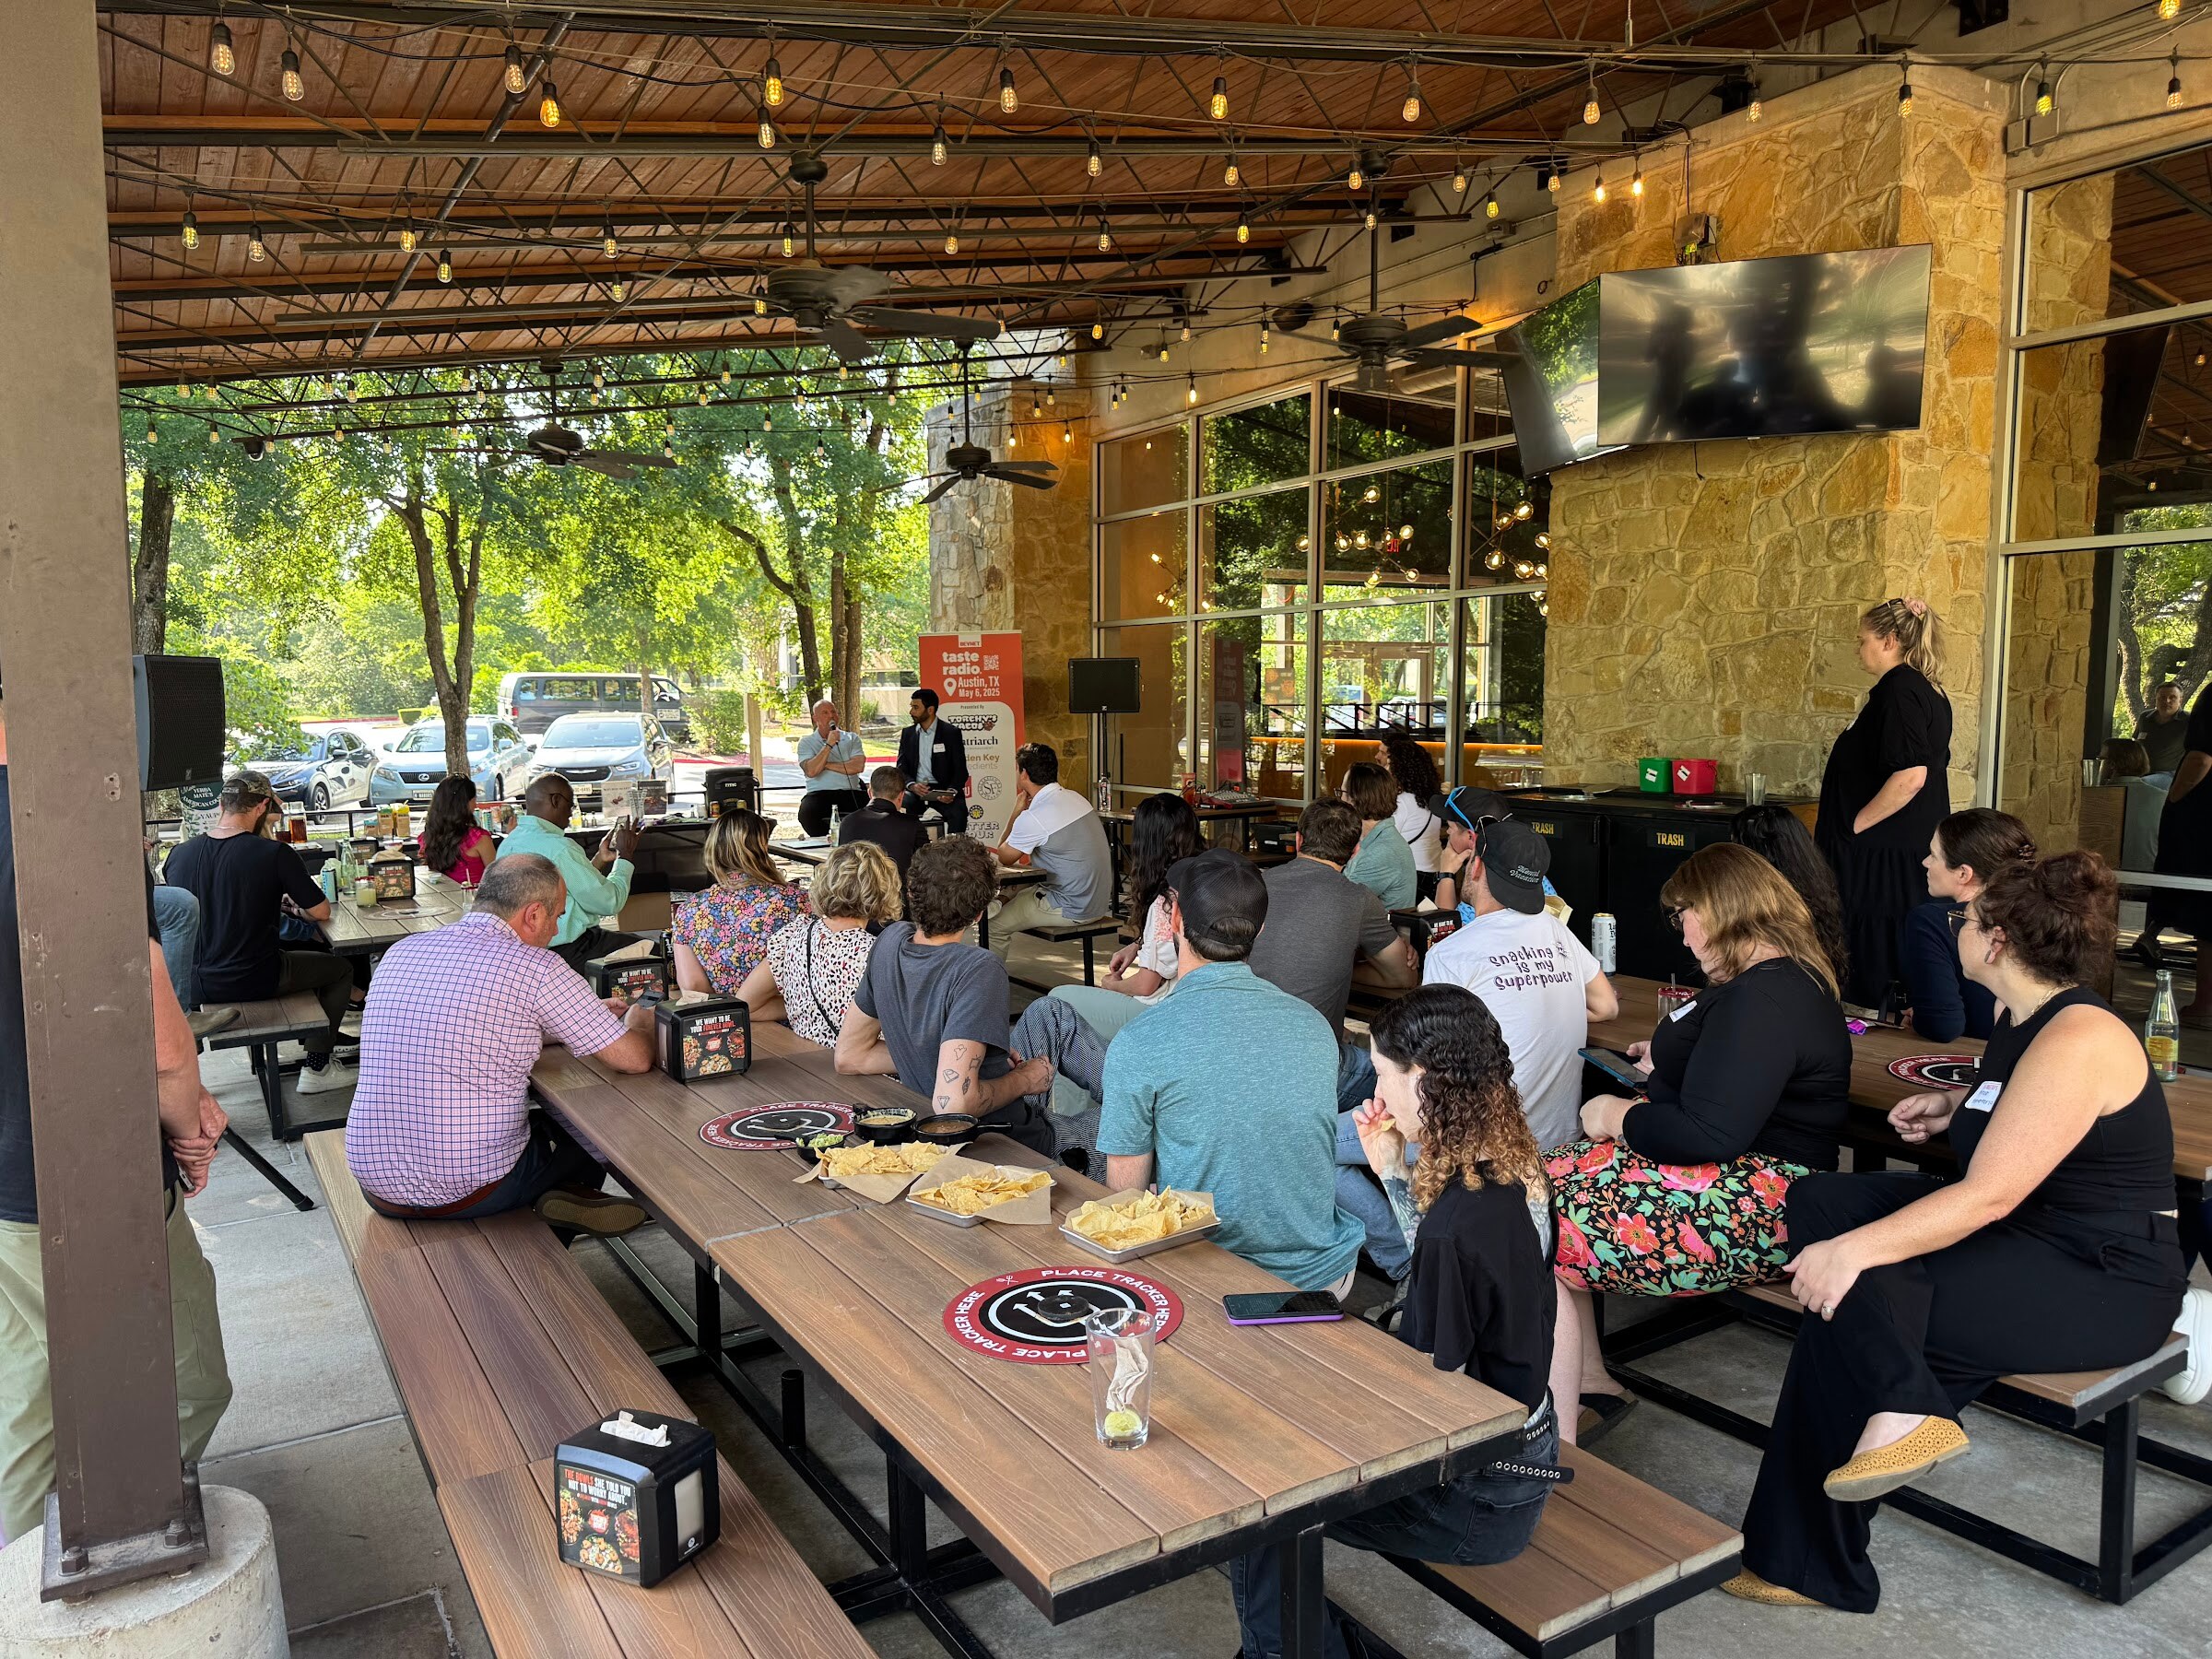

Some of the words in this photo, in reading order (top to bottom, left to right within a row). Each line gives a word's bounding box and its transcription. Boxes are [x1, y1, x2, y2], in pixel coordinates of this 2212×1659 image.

[942, 651, 980, 663] taste
[958, 677, 988, 688] Austin,
[988, 676, 1000, 687] TX
[959, 688, 973, 699] May
[975, 688, 982, 698] 6,
[982, 688, 1000, 697] 2025
[948, 714, 998, 724] TORCHY'S
[962, 735, 998, 746] atriarch
[982, 754, 1000, 762] Key
[1532, 821, 1555, 835] TRASH
[1656, 832, 1685, 847] TRASH
[1515, 961, 1530, 973] is
[1535, 959, 1554, 972] my
[1494, 971, 1573, 991] Superpower
[695, 1018, 704, 1027] WE
[703, 1017, 717, 1025] WANT
[689, 1025, 702, 1034] YOUR
[749, 1103, 796, 1112] PLACE
[955, 1290, 985, 1315] HERE
[1041, 1269, 1107, 1277] PLACE
[1112, 1273, 1168, 1307] TRACKER
[1155, 1307, 1171, 1333] HER
[954, 1315, 1007, 1353] TRACKER
[1012, 1347, 1088, 1359] PLACE
[564, 1468, 575, 1480] THE
[575, 1472, 594, 1486] BOWLS
[594, 1477, 605, 1489] SHE
[605, 1480, 619, 1493] TOLD
[619, 1484, 631, 1497] YOU
[568, 1479, 579, 1491] NOT
[580, 1482, 588, 1493] TO
[588, 1485, 607, 1500] WORRY
